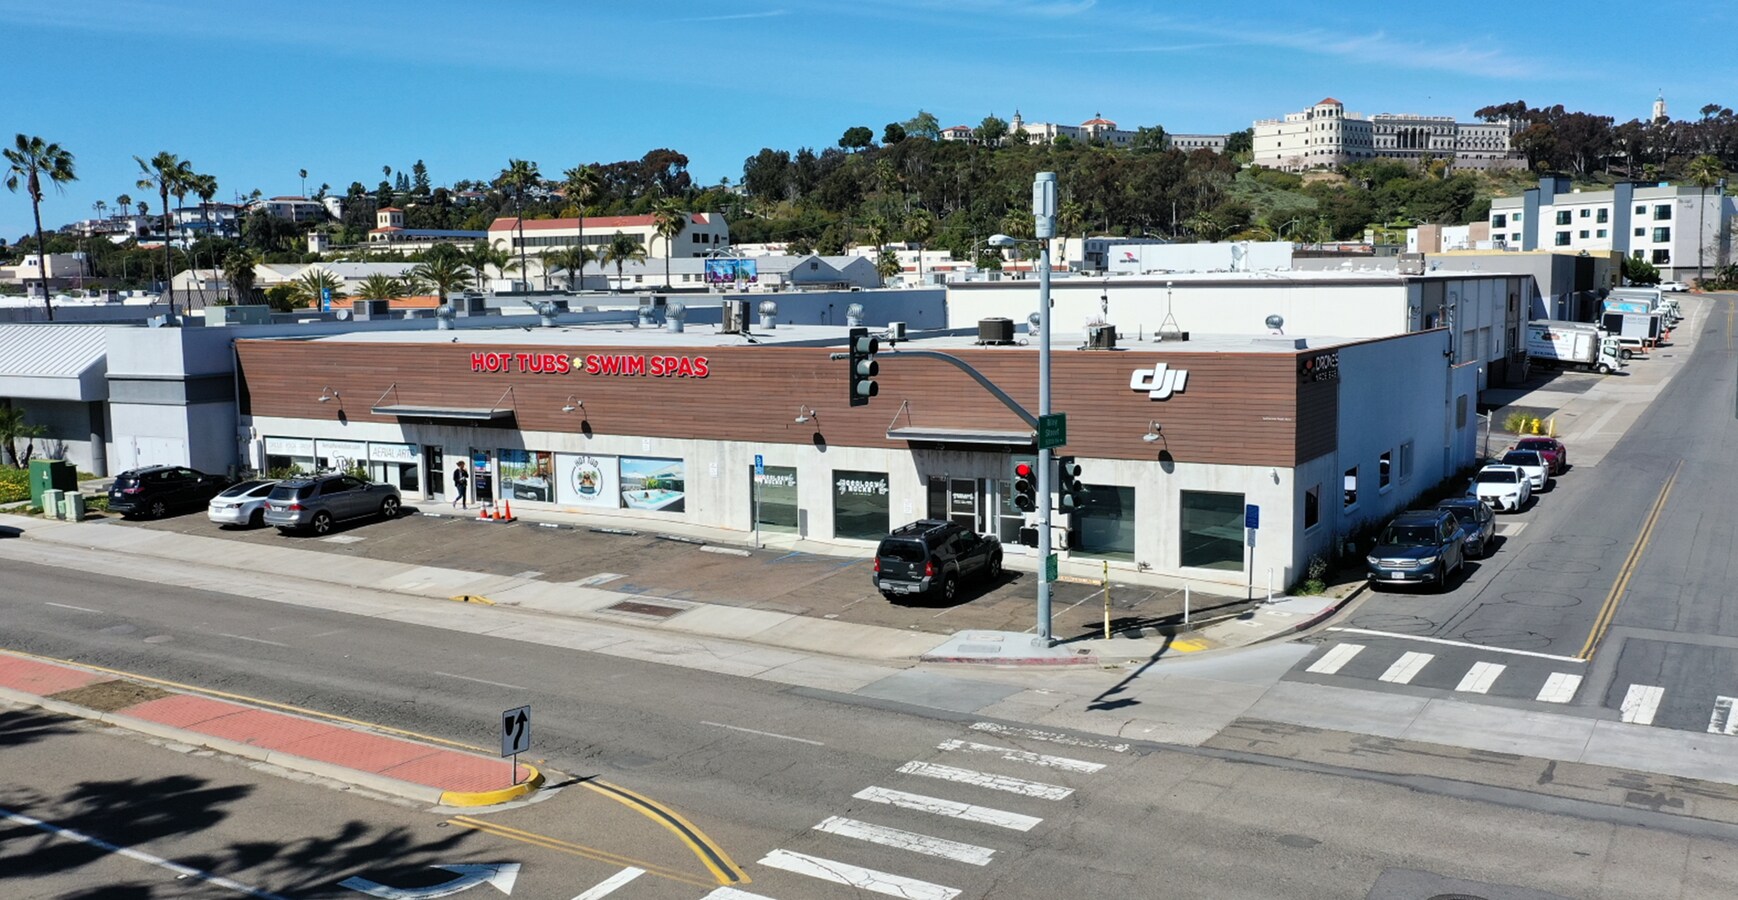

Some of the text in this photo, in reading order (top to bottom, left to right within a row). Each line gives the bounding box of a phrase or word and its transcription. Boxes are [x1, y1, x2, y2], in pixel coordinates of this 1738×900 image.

[471, 352, 709, 378] HOT TUBS SWIM SPAS
[372, 446, 396, 458] AERIAL
[574, 455, 599, 468] HOT TUB
[845, 479, 880, 488] GEOLOGY
